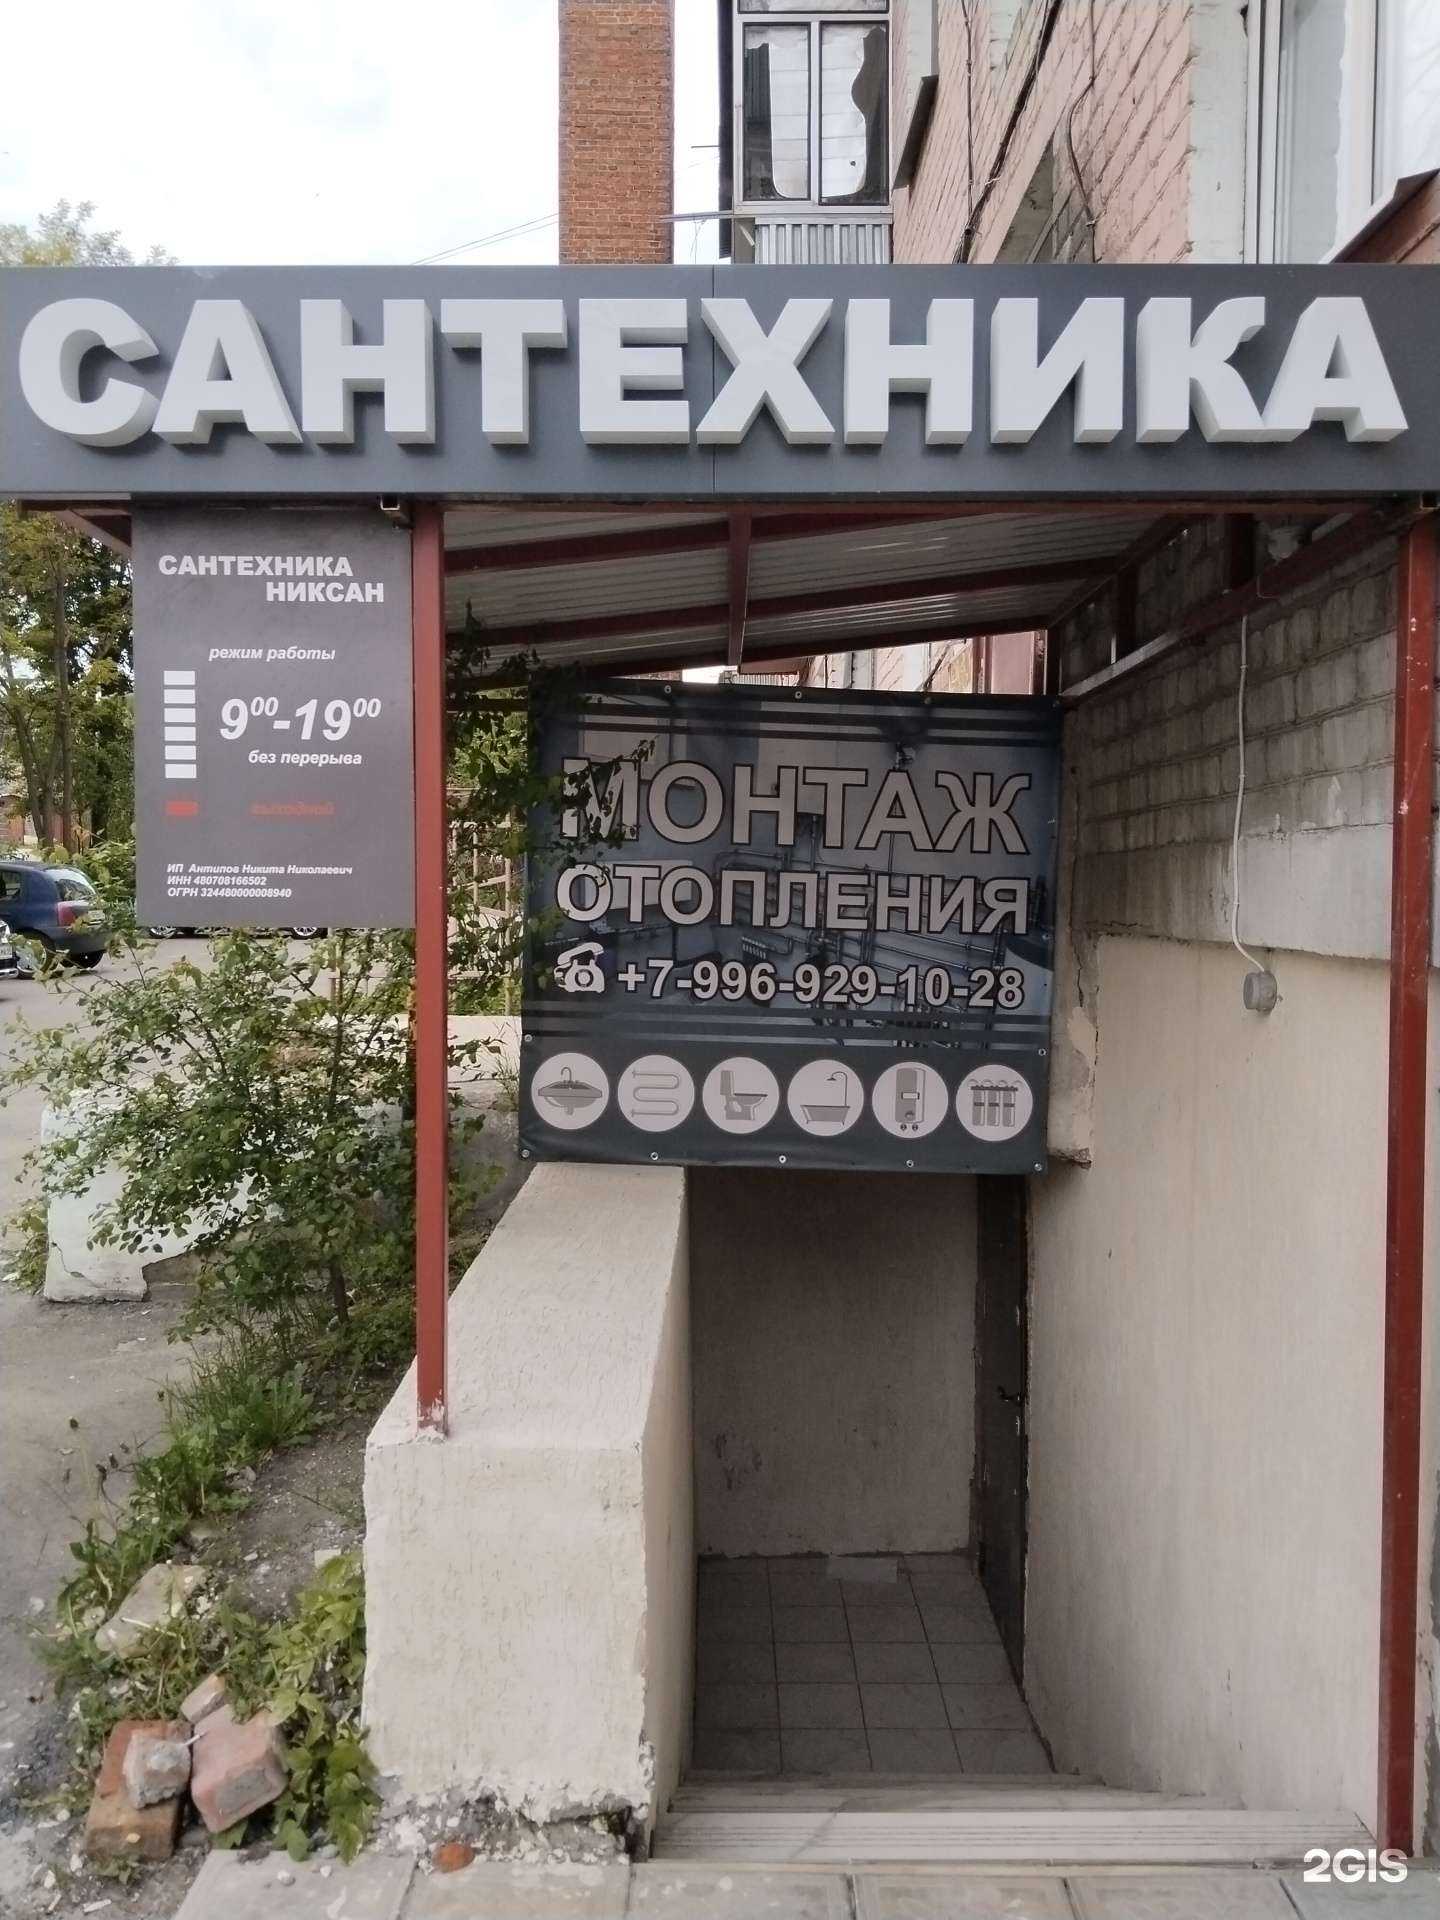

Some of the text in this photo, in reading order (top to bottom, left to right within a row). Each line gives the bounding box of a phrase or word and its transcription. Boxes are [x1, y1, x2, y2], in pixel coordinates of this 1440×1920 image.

[18, 297, 1408, 446] САНТЕХНИКА
[158, 555, 353, 577] САНТЕХНИКА
[266, 582, 385, 603] НИКСАН
[208, 646, 336, 662] режим работы
[248, 750, 362, 767] без перерыва
[560, 757, 1033, 856] МОНТАЖ
[167, 864, 183, 873] ИП
[188, 864, 239, 874] Антипов
[242, 864, 285, 874] Никита
[167, 876, 191, 885] ИНН
[168, 887, 198, 897] ОГРН
[555, 863, 1031, 936] ОТОПЛЕНИЯ
[617, 957, 1027, 1010] +7-996-929-10-28
